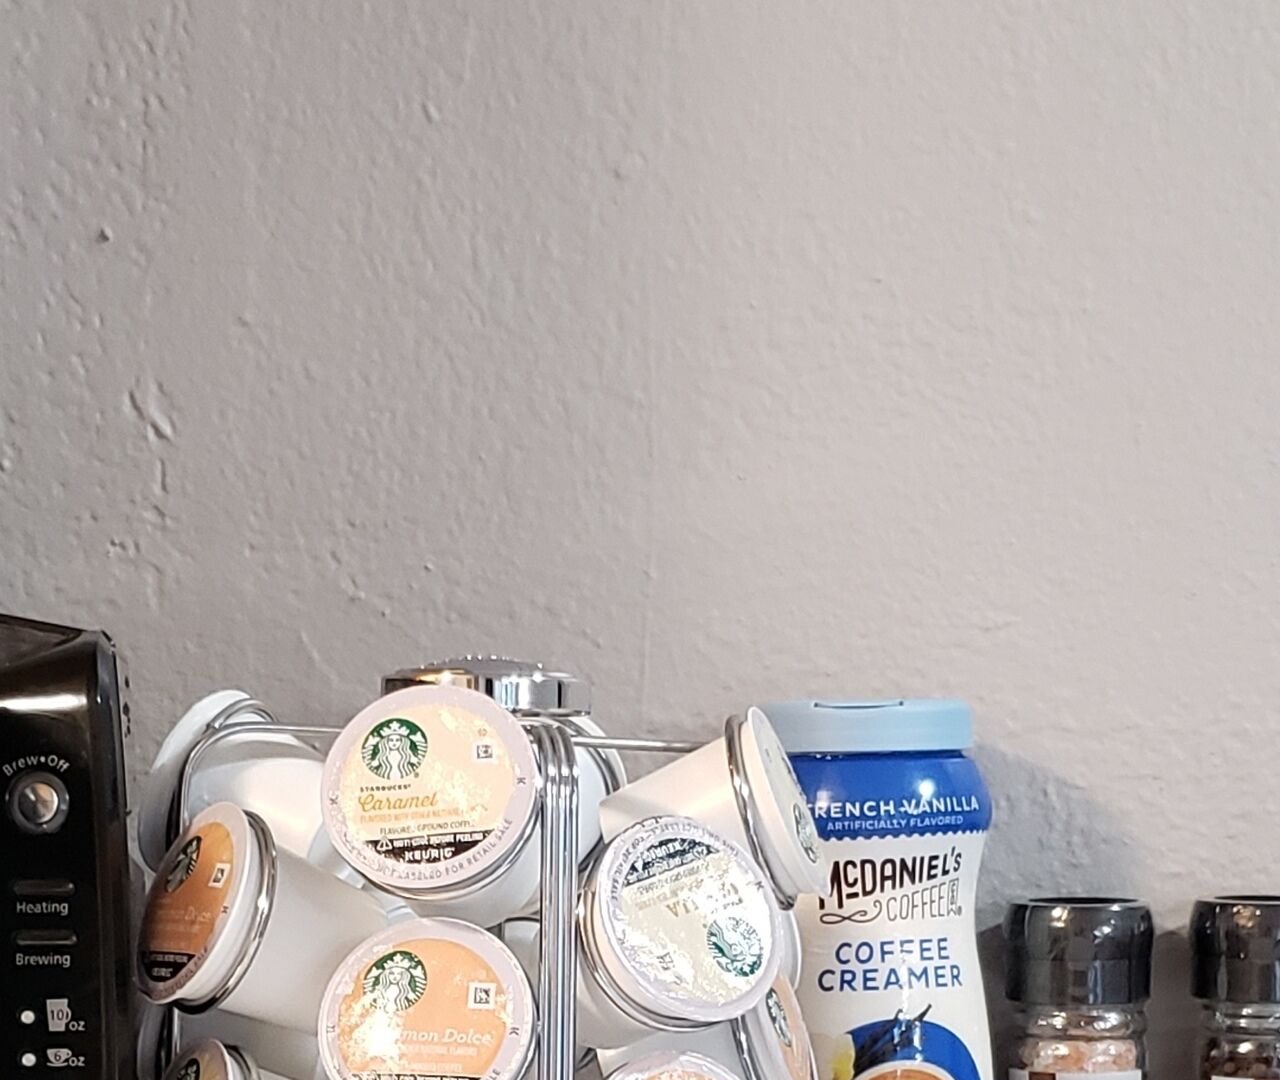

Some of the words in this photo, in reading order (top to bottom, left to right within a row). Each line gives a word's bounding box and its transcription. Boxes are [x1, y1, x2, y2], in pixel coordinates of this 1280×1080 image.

[358, 791, 439, 812] Caramel
[807, 801, 895, 819] RENCH
[902, 795, 979, 814] VANILLA
[827, 818, 908, 831] ARTIFICIALLY
[910, 816, 964, 827] FLAVORED
[405, 847, 455, 862] KEURIG
[445, 862, 465, 875] FOR
[465, 841, 497, 865] RETAIL
[497, 817, 513, 841] SALE
[16, 901, 69, 916] Heating
[886, 882, 947, 922] COFFEE
[16, 953, 70, 968] Brewing
[835, 937, 950, 965] COFFEE
[818, 965, 963, 992] CREAMER
[50, 1009, 64, 1021] 10
[70, 1020, 85, 1031] oz
[443, 1028, 493, 1046] Dolce
[69, 1057, 85, 1066] oz
